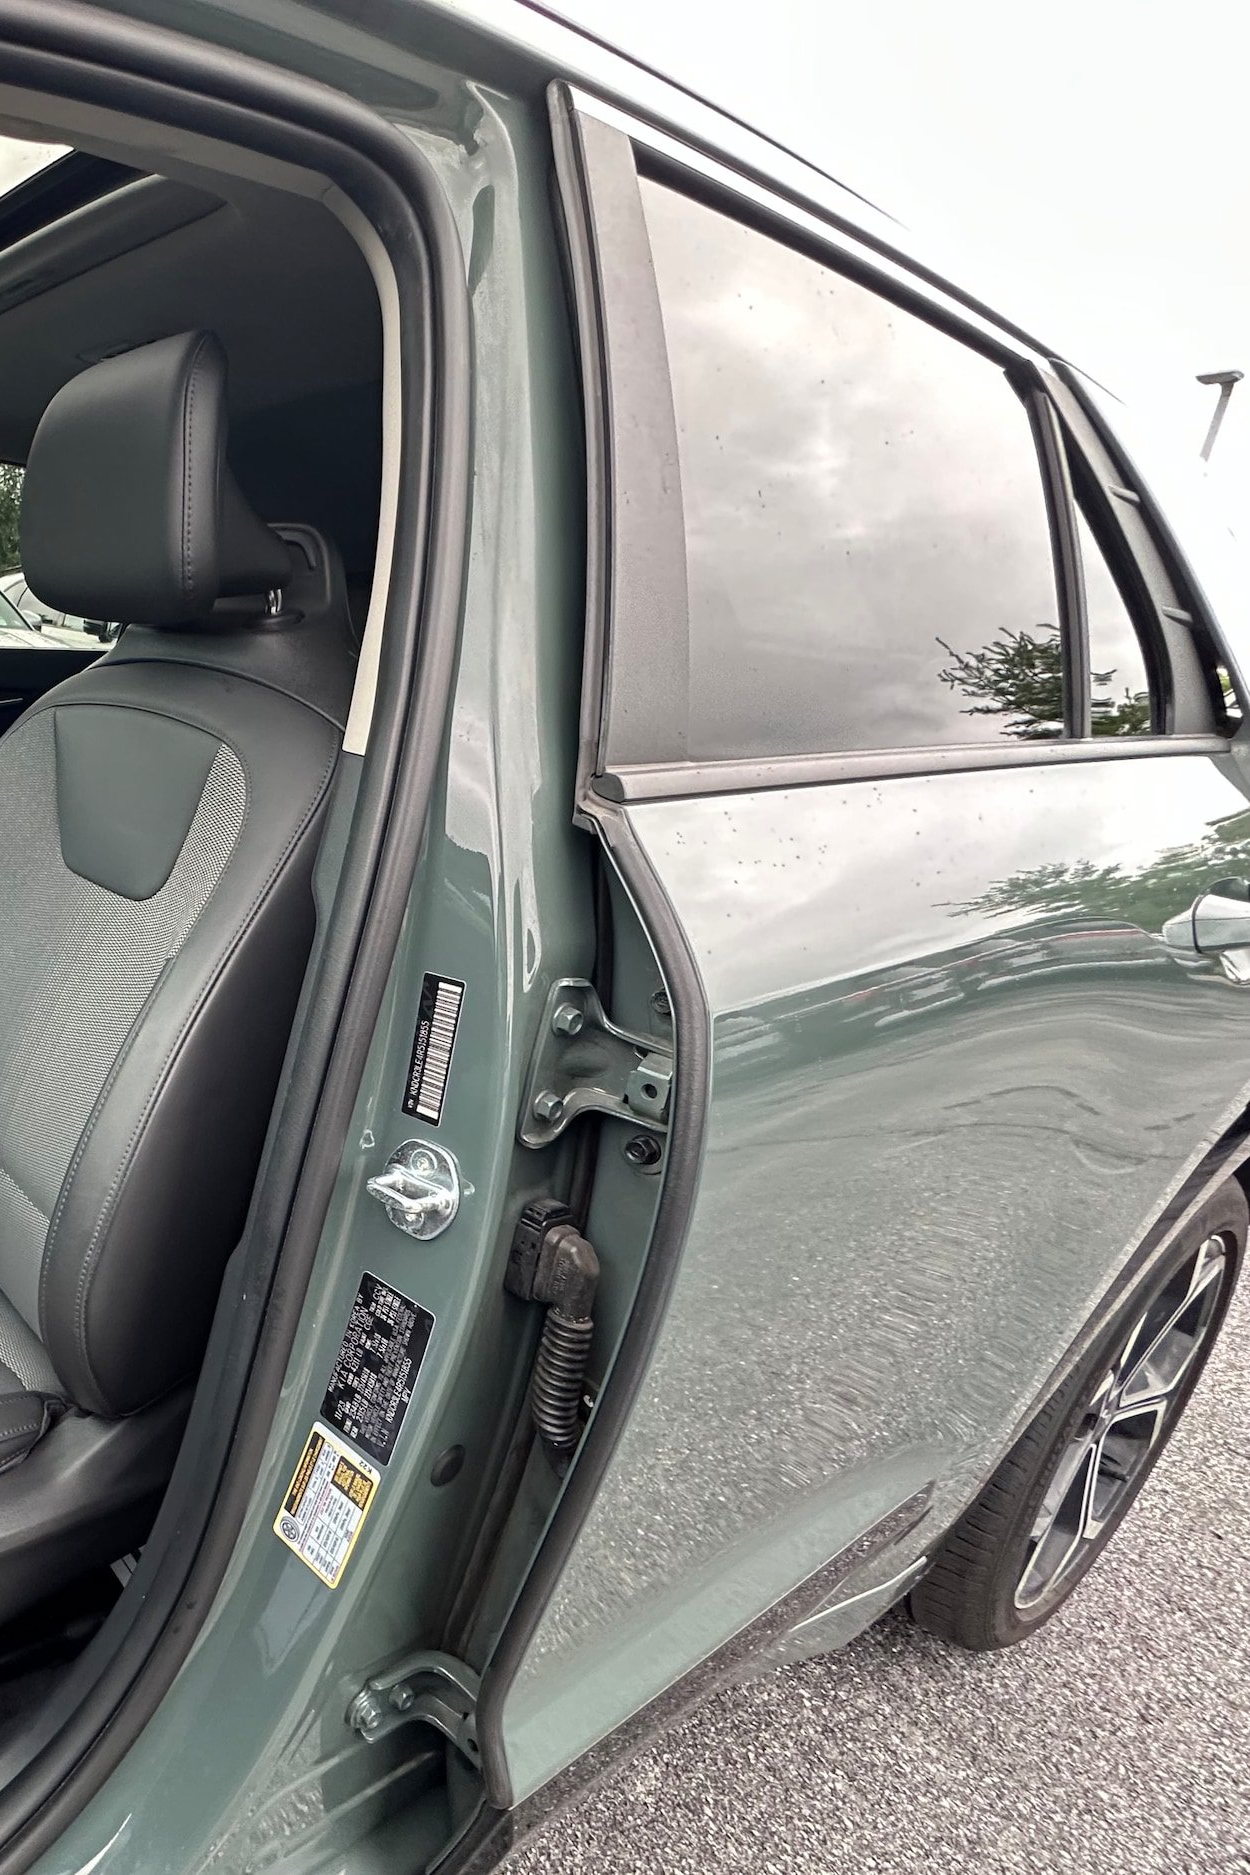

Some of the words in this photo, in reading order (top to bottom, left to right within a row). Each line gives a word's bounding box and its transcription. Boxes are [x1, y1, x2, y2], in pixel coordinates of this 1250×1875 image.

[328, 1341, 349, 1392] MANUFACTURED
[349, 1305, 360, 1328] KOREA
[343, 1306, 368, 1368] CORPORATION
